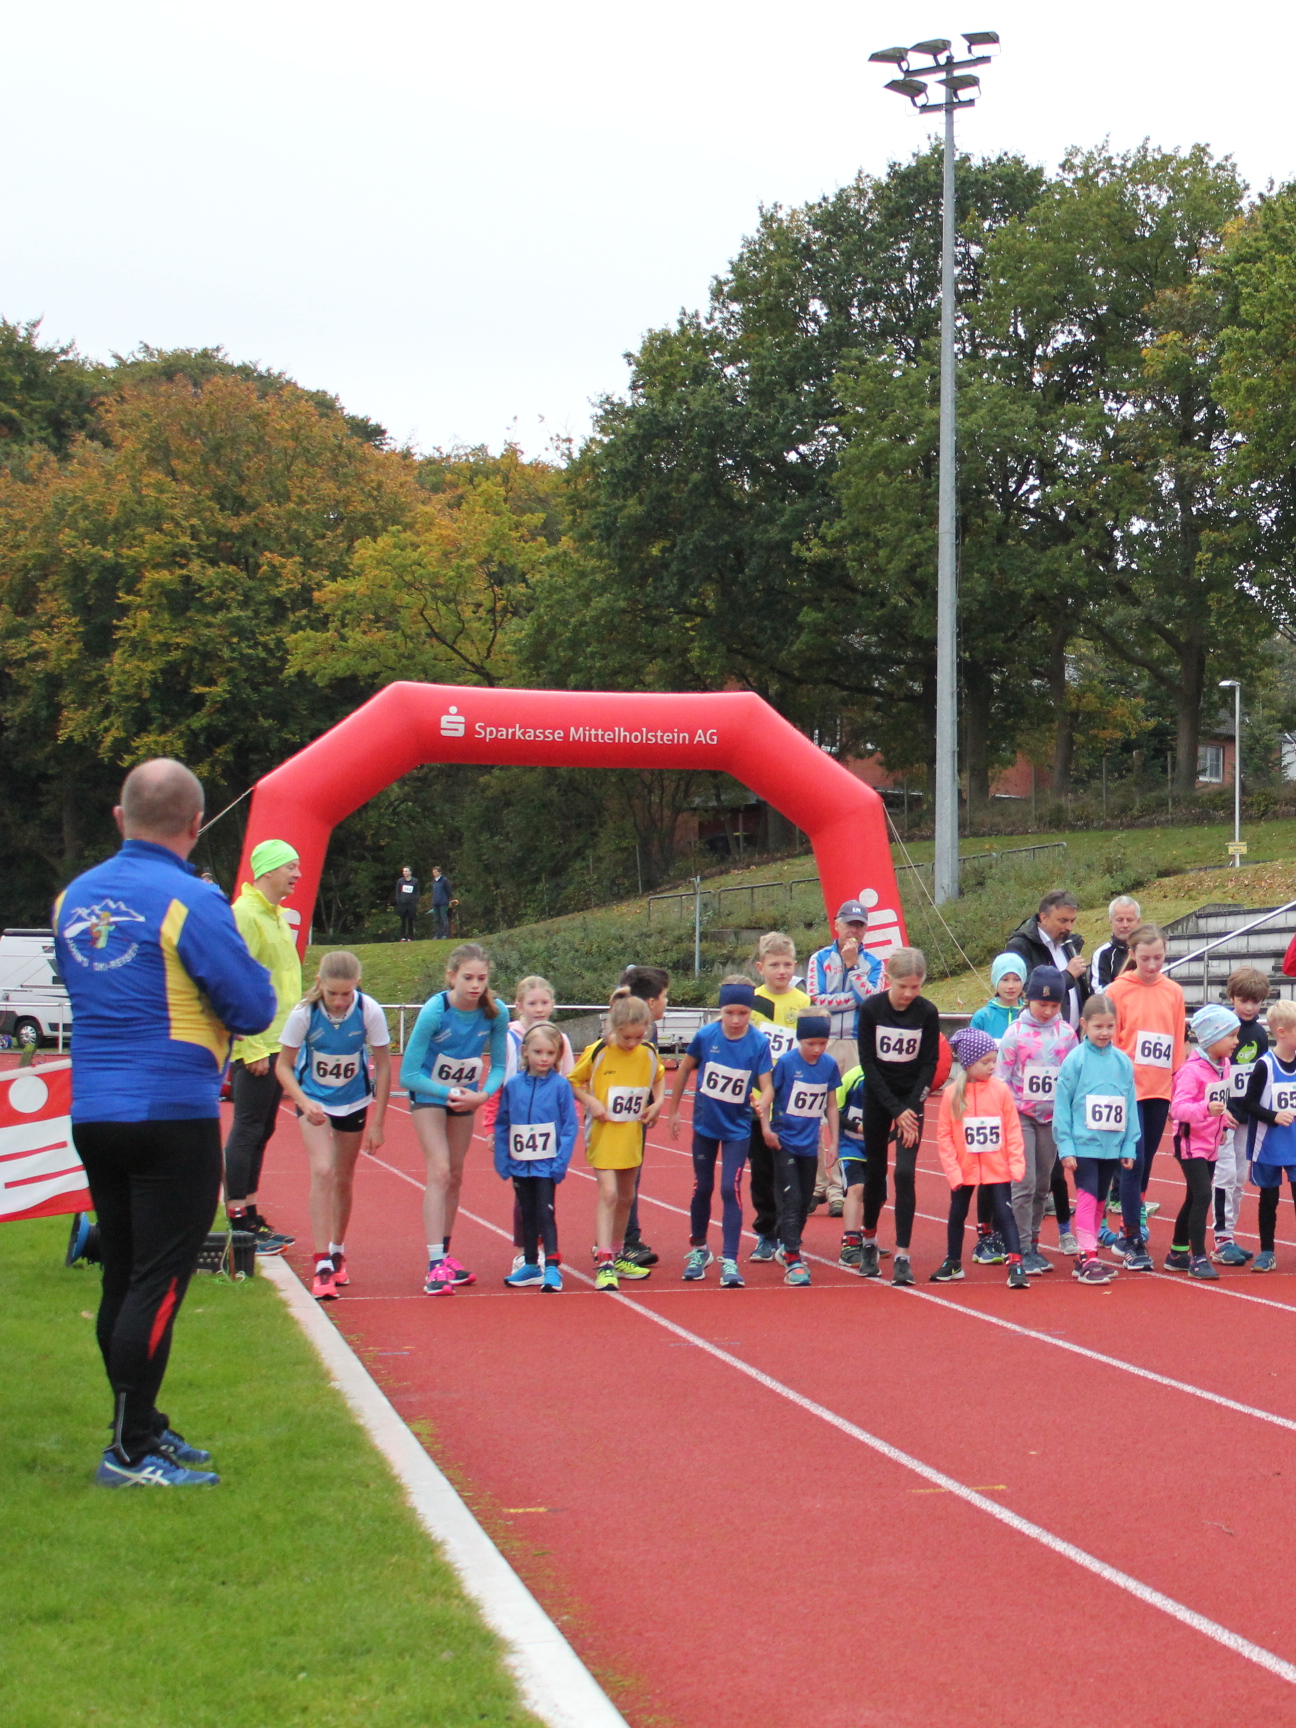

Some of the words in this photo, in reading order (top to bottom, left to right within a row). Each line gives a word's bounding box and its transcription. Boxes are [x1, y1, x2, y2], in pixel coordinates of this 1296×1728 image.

[474, 722, 564, 743] Sparkasse
[569, 726, 689, 745] Mittelholstein
[693, 729, 719, 745] AG
[879, 1035, 918, 1055] 648
[1140, 1039, 1172, 1061] 664
[315, 1060, 357, 1080] 646
[437, 1063, 478, 1083] 644
[706, 1070, 745, 1097] 676
[1028, 1075, 1058, 1094] 66
[612, 1095, 643, 1115] 645
[793, 1090, 827, 1111] 677
[1091, 1103, 1123, 1124] 678
[513, 1132, 551, 1153] 647
[964, 1125, 1001, 1146] 655
